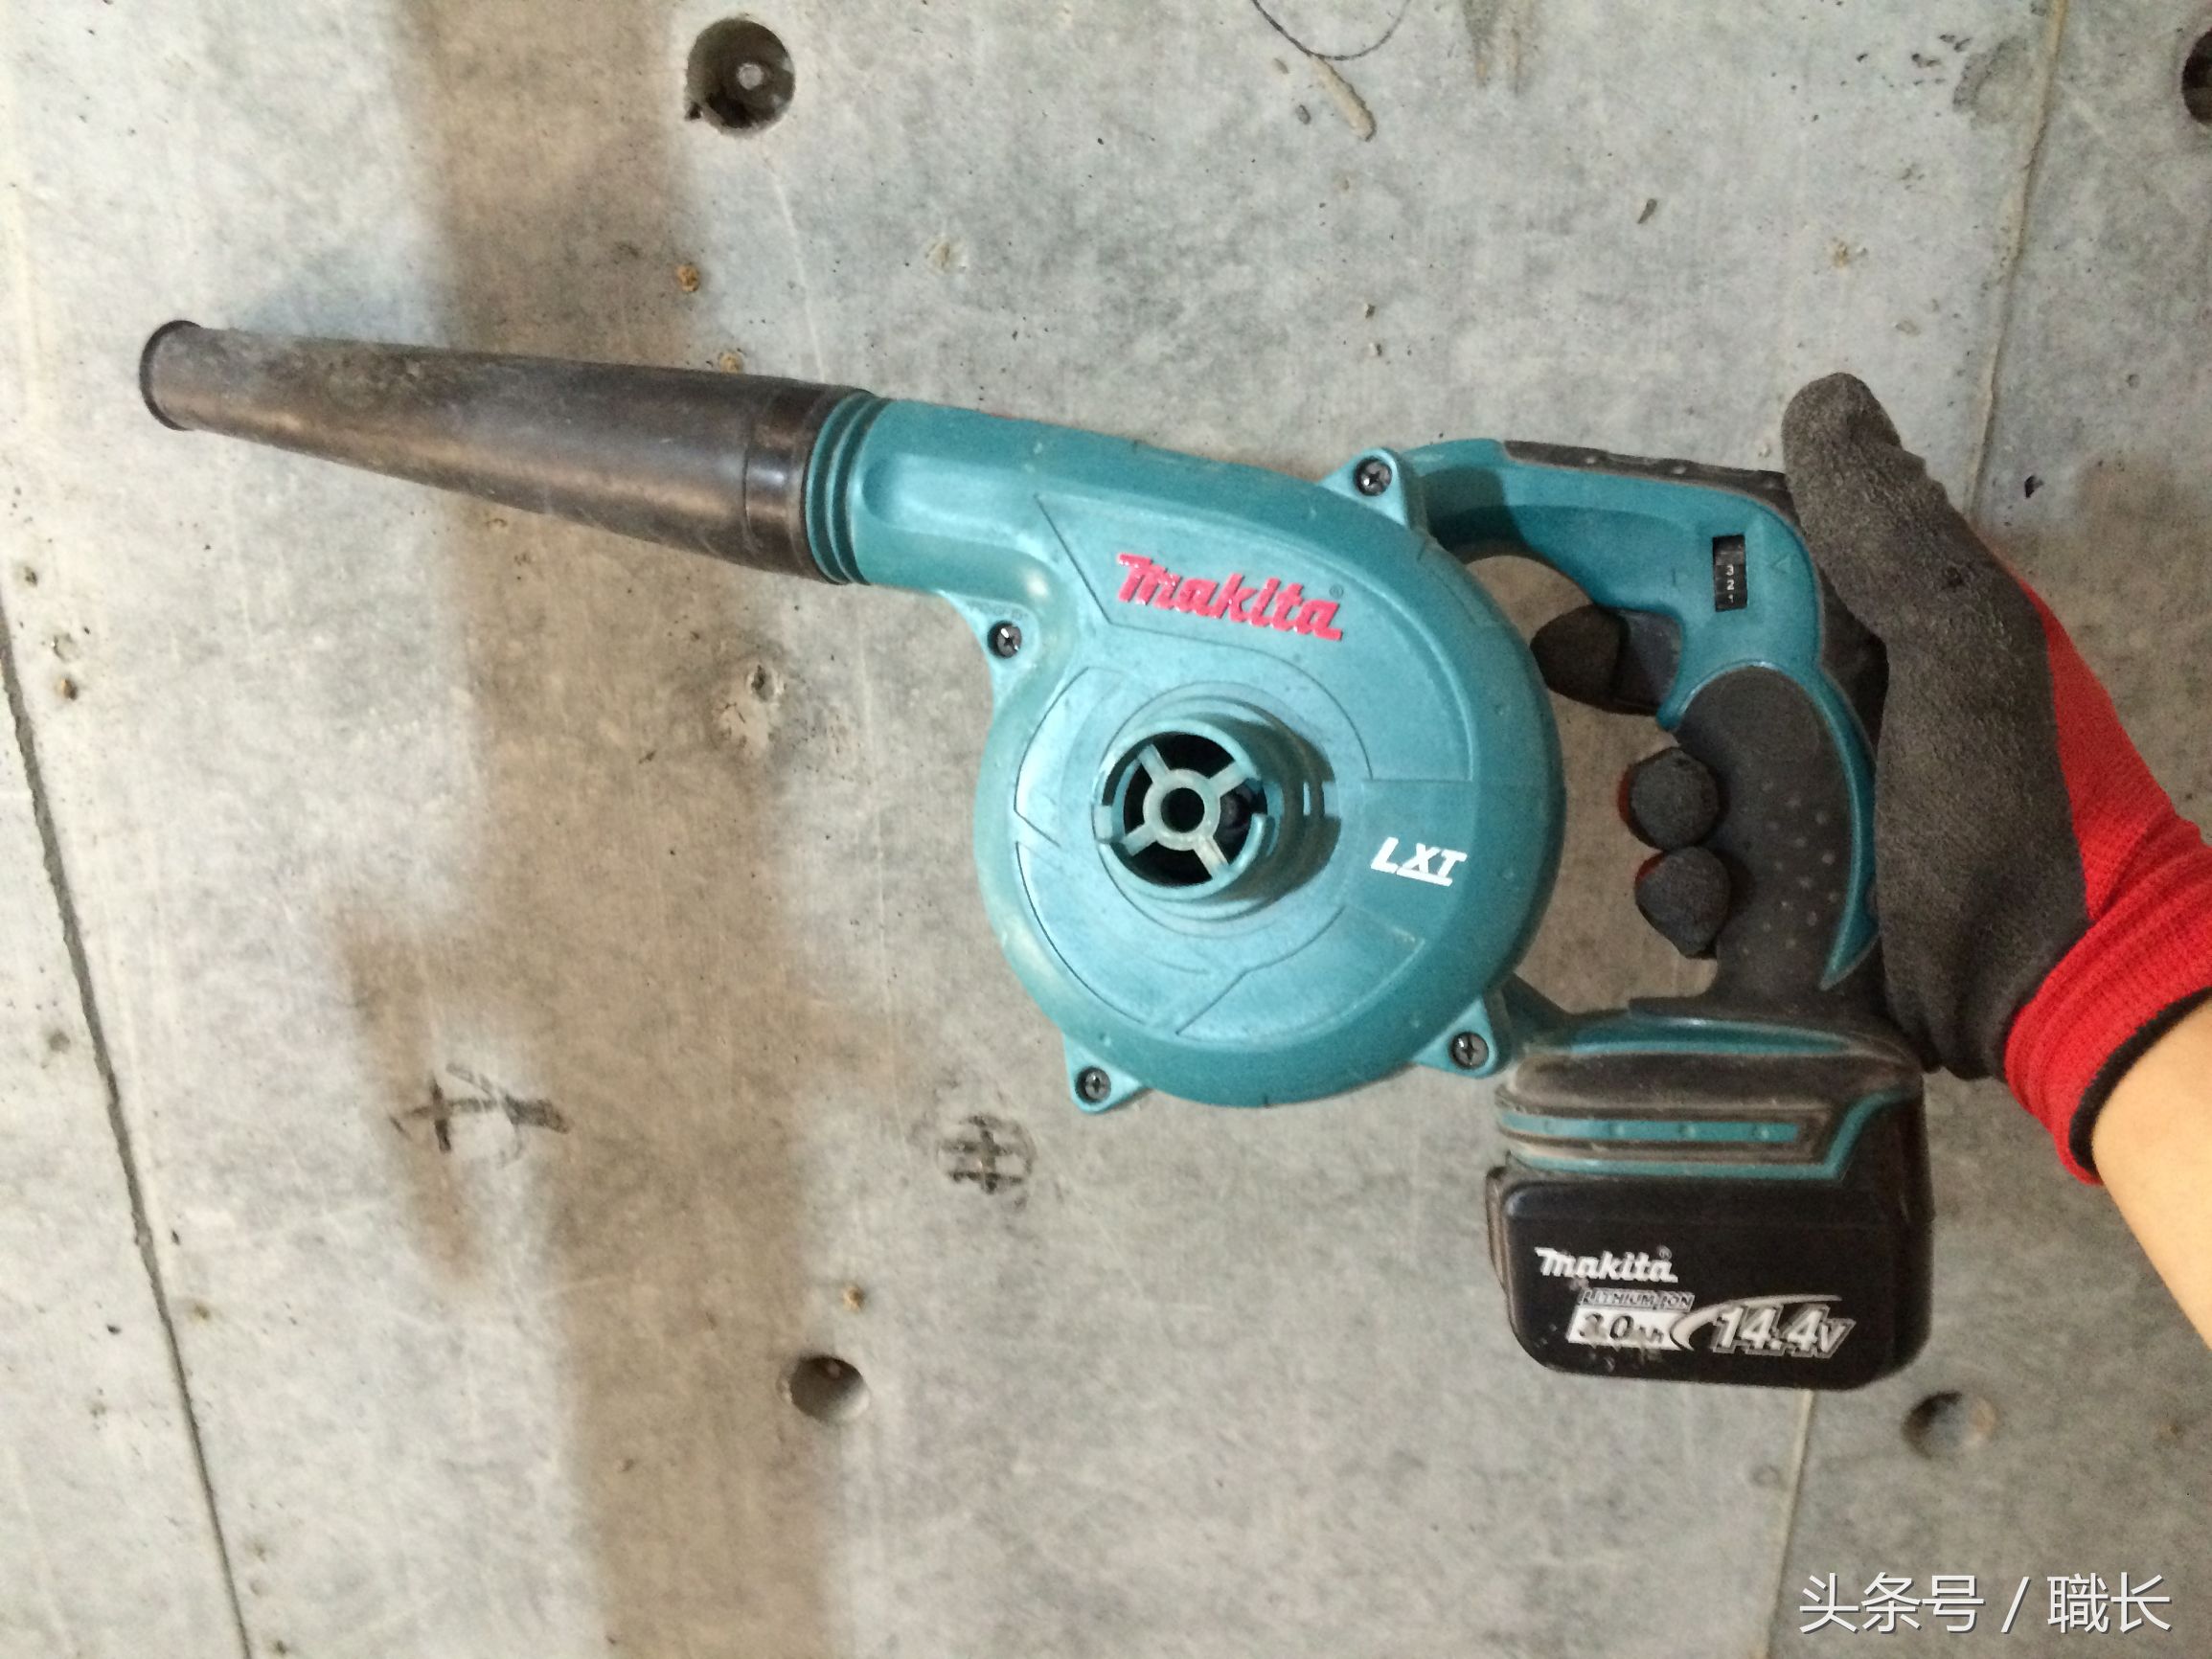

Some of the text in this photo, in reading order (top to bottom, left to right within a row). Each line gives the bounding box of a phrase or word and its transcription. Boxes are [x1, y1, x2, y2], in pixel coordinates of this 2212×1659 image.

[1726, 564, 1734, 576] 3
[1727, 580, 1735, 591] 2
[1370, 836, 1468, 887] LXT
